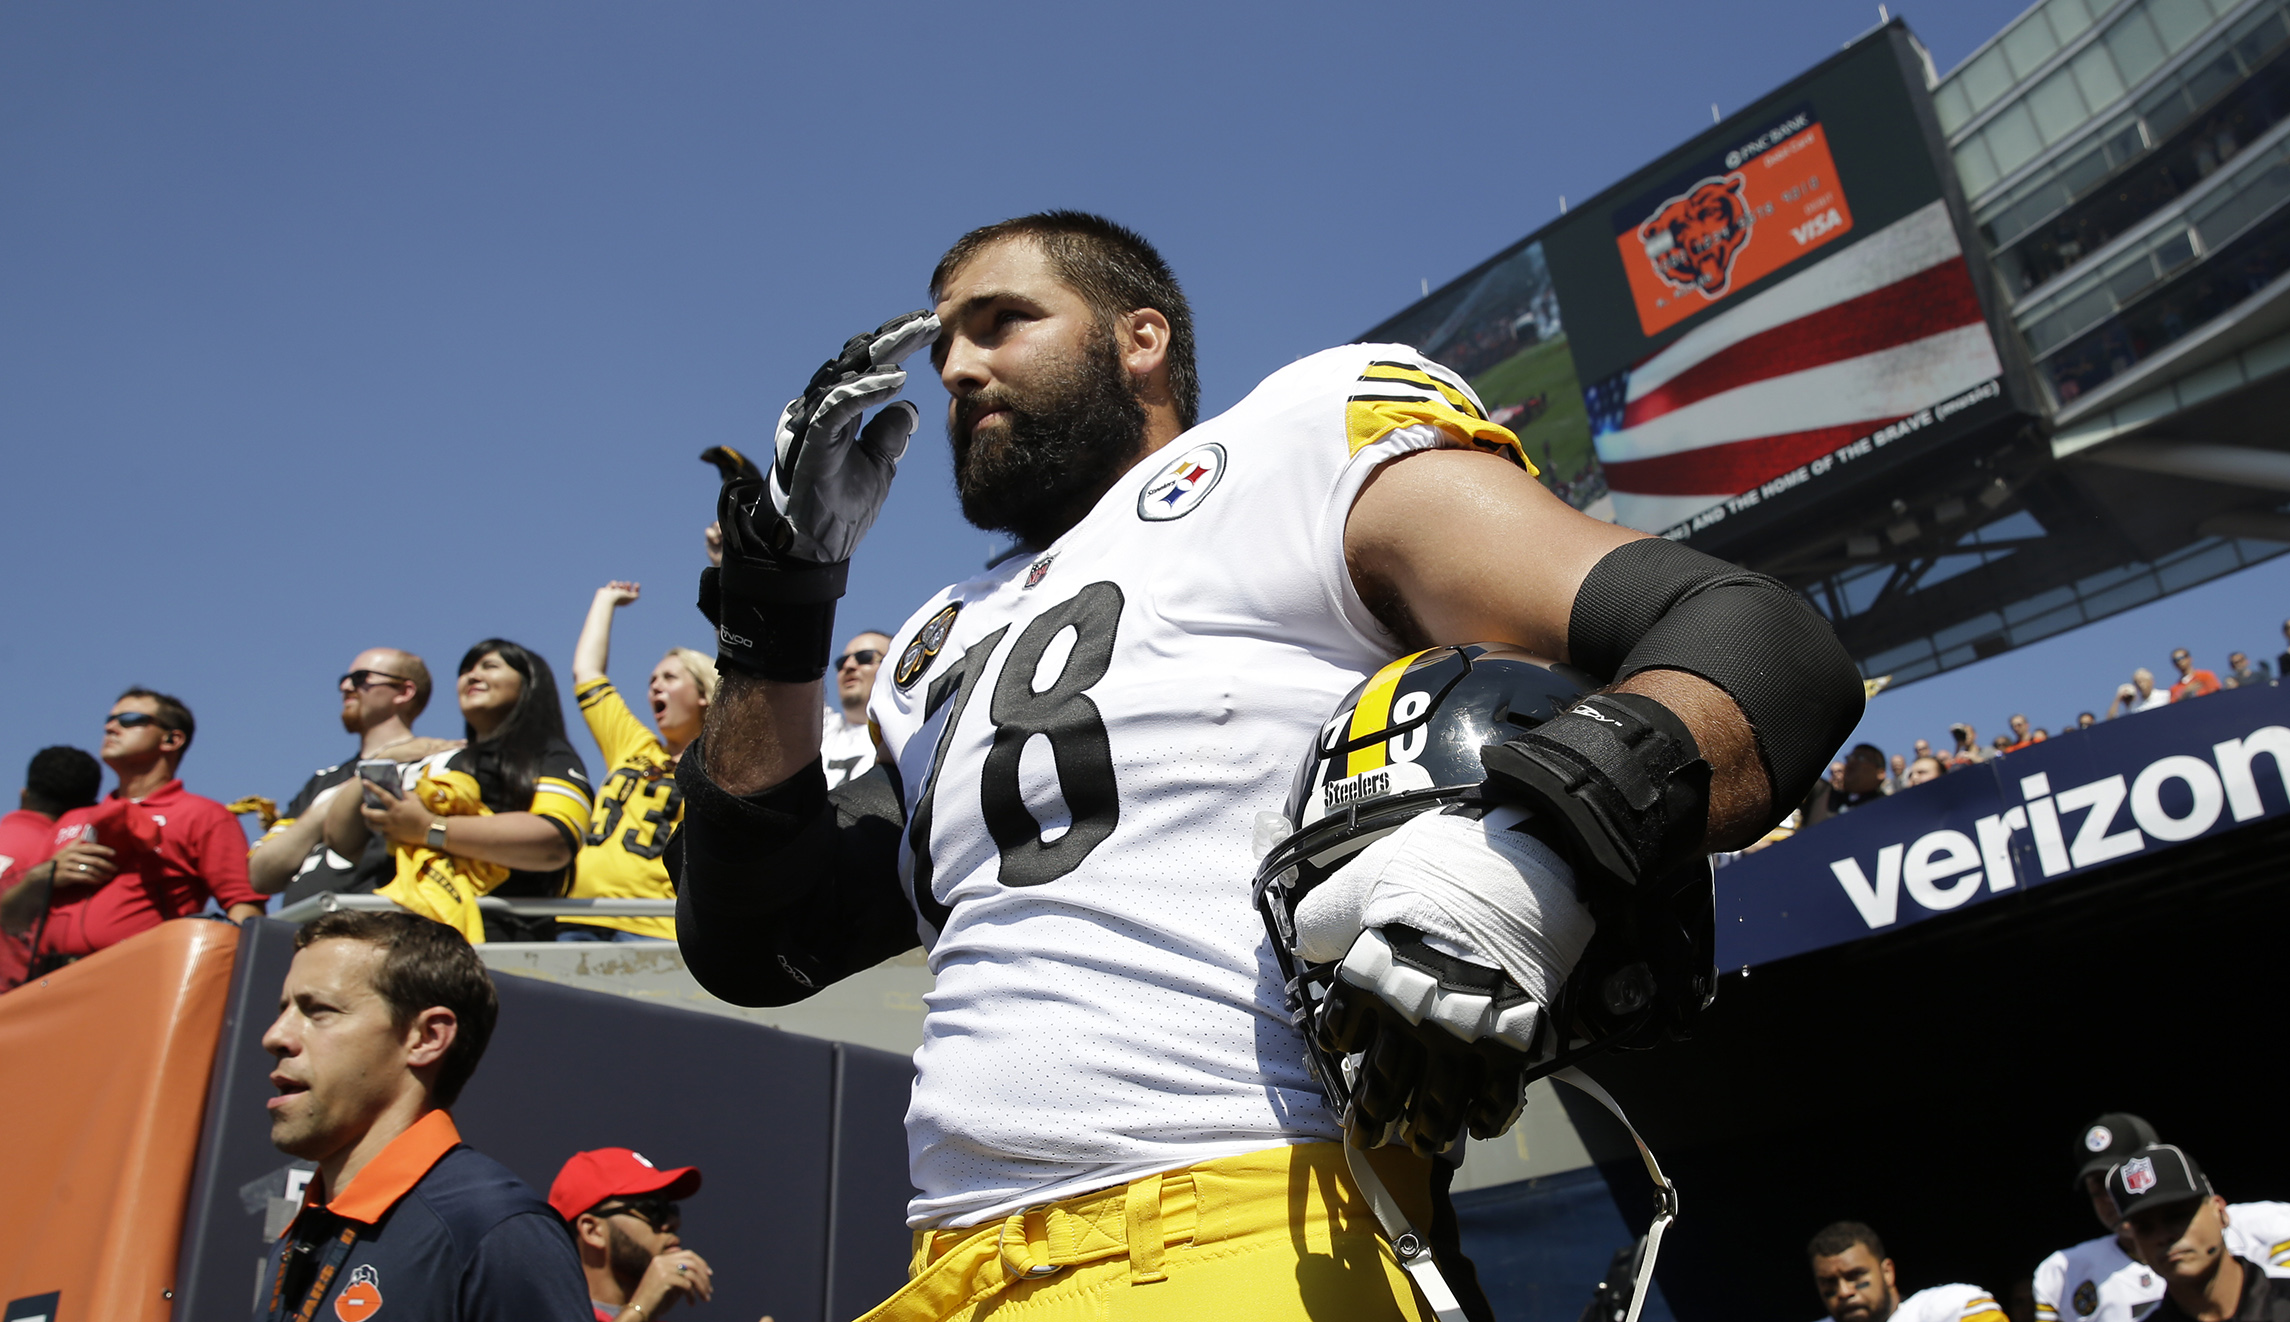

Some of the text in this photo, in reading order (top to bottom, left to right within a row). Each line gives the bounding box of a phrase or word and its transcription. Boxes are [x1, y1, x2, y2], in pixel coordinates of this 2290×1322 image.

[1789, 207, 1843, 245] VISA
[1692, 505, 1726, 532] AND
[1727, 488, 1761, 515] THE
[1760, 465, 1811, 499] HOME
[1811, 454, 1834, 476] OF
[1835, 437, 1873, 464] THE
[1872, 408, 1934, 448] BRAVE
[908, 580, 1125, 936] 78
[1324, 771, 1392, 808] Steelers
[1829, 725, 2290, 929] verizon
